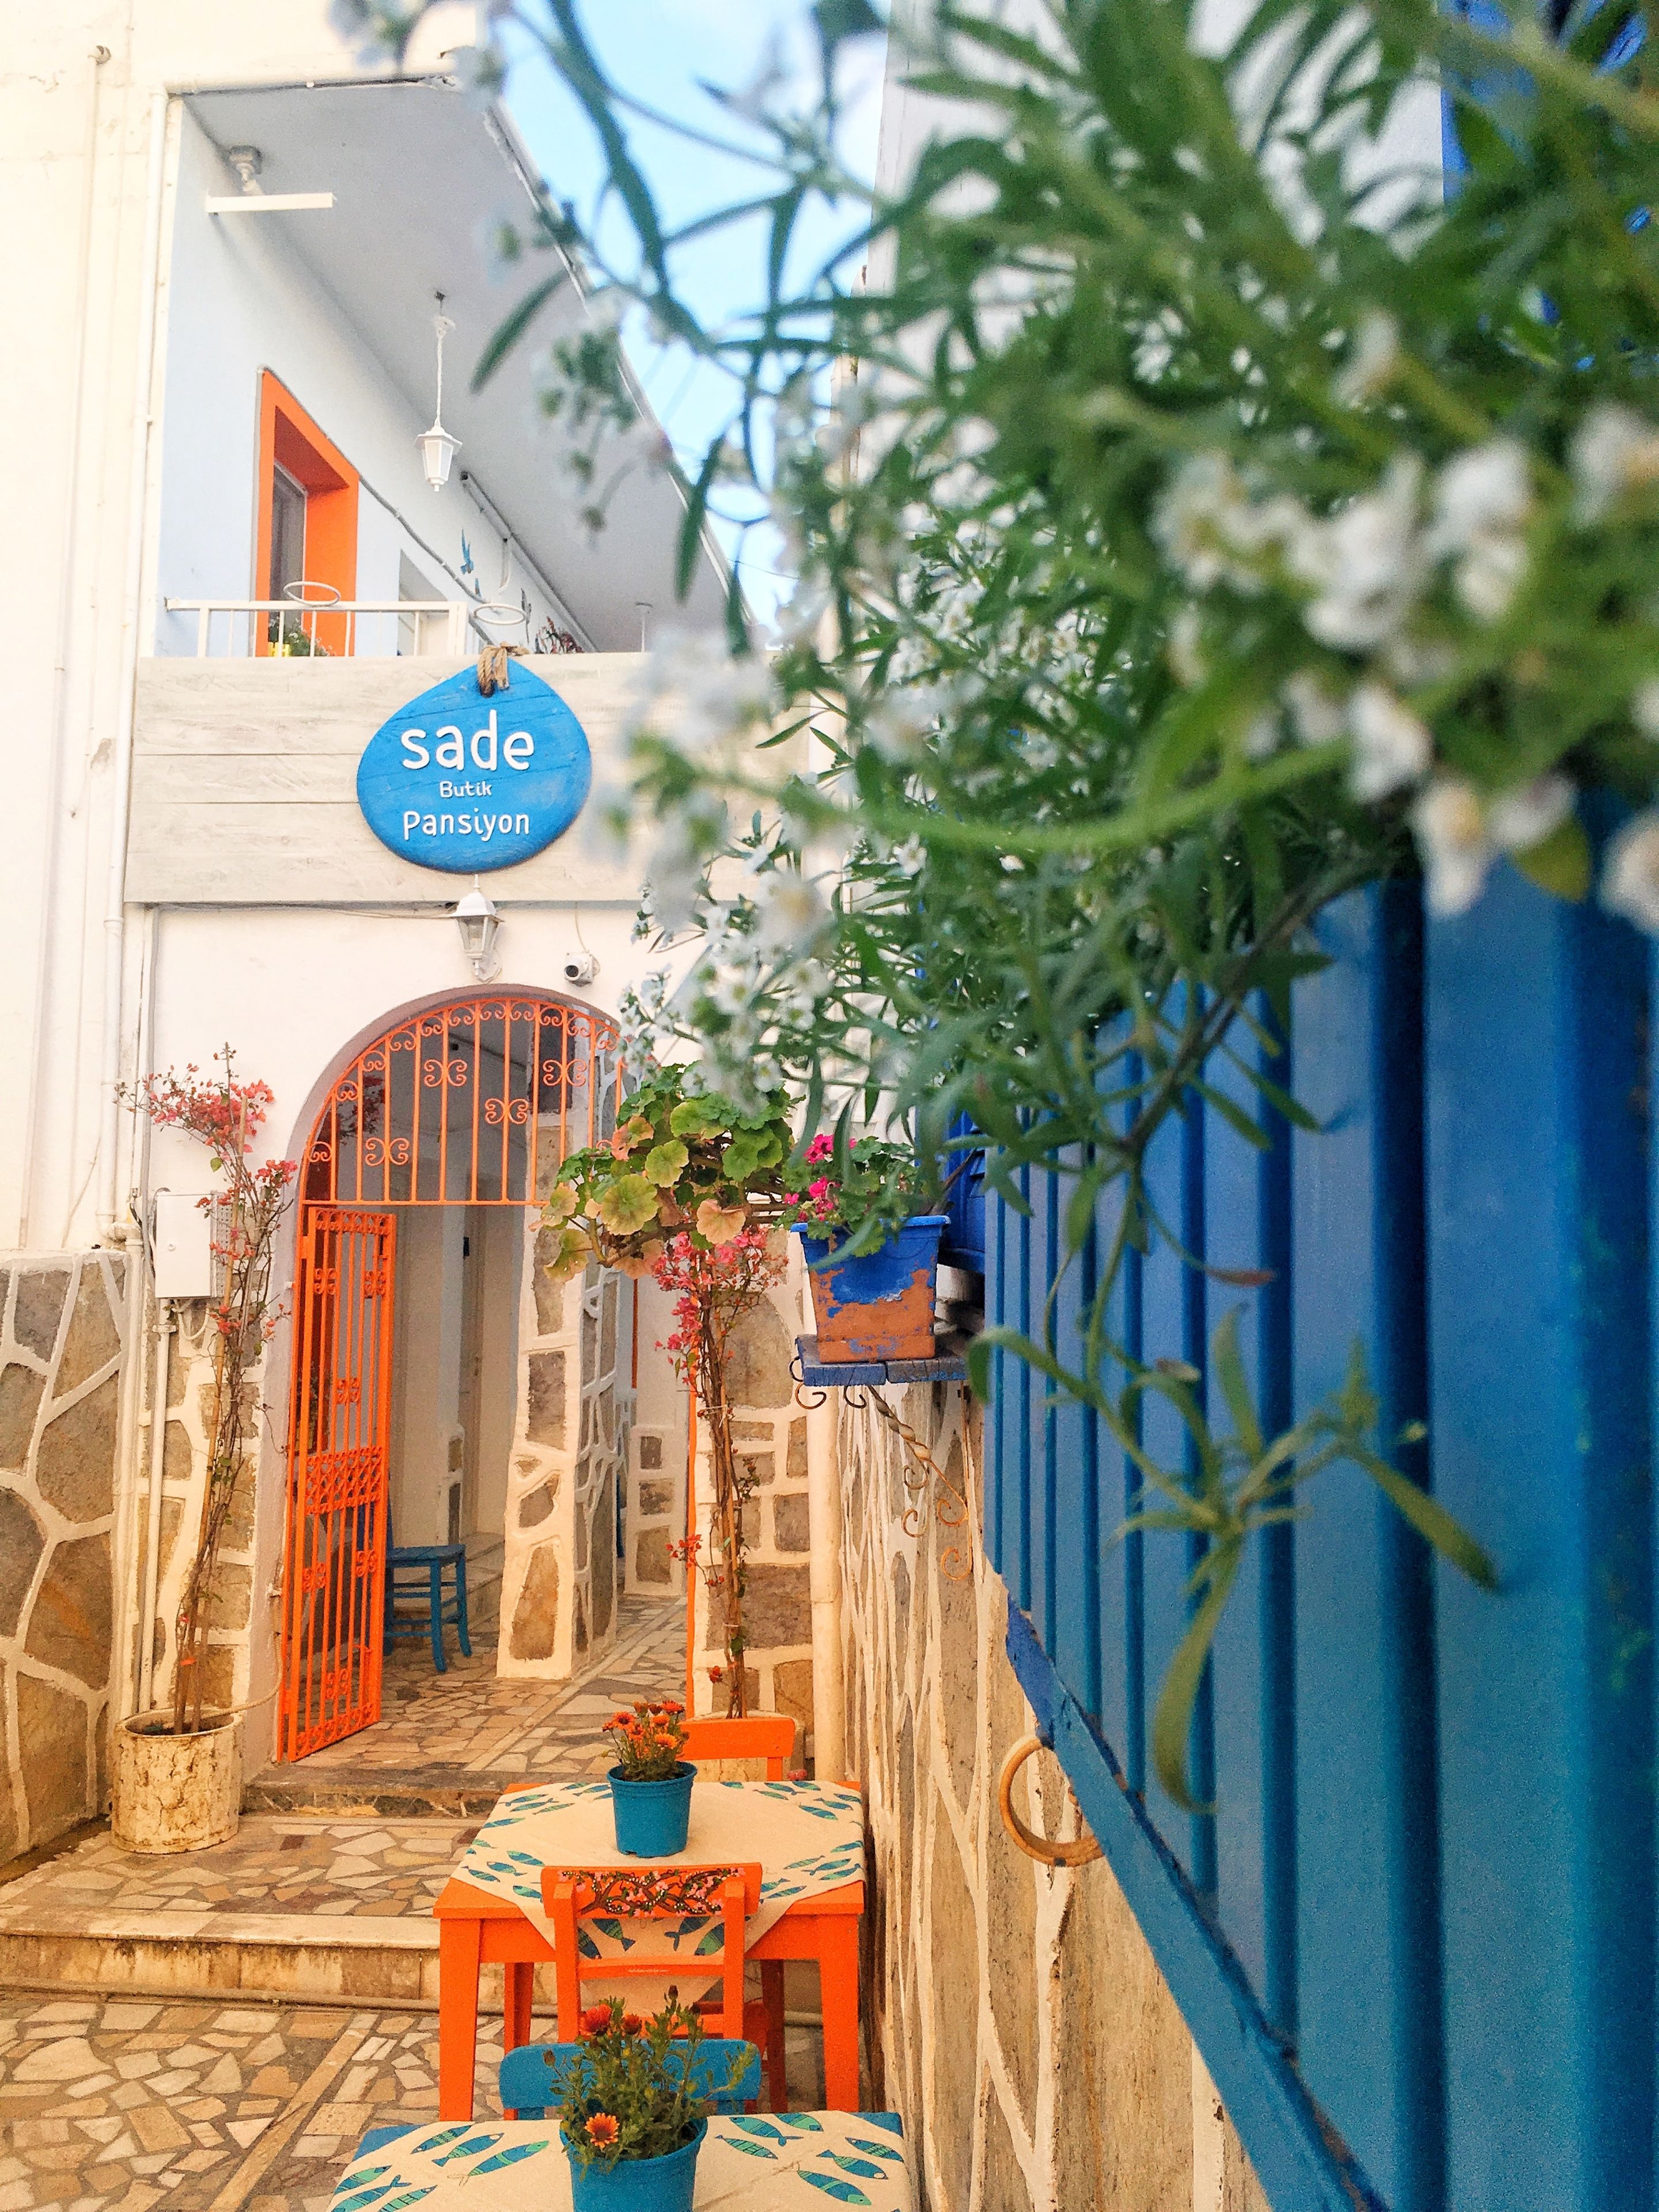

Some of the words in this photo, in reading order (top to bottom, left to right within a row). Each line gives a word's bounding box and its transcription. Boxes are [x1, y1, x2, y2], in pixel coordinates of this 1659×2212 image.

[400, 709, 535, 771] sade
[440, 781, 492, 798] Butik
[403, 808, 529, 842] Pansiyon
